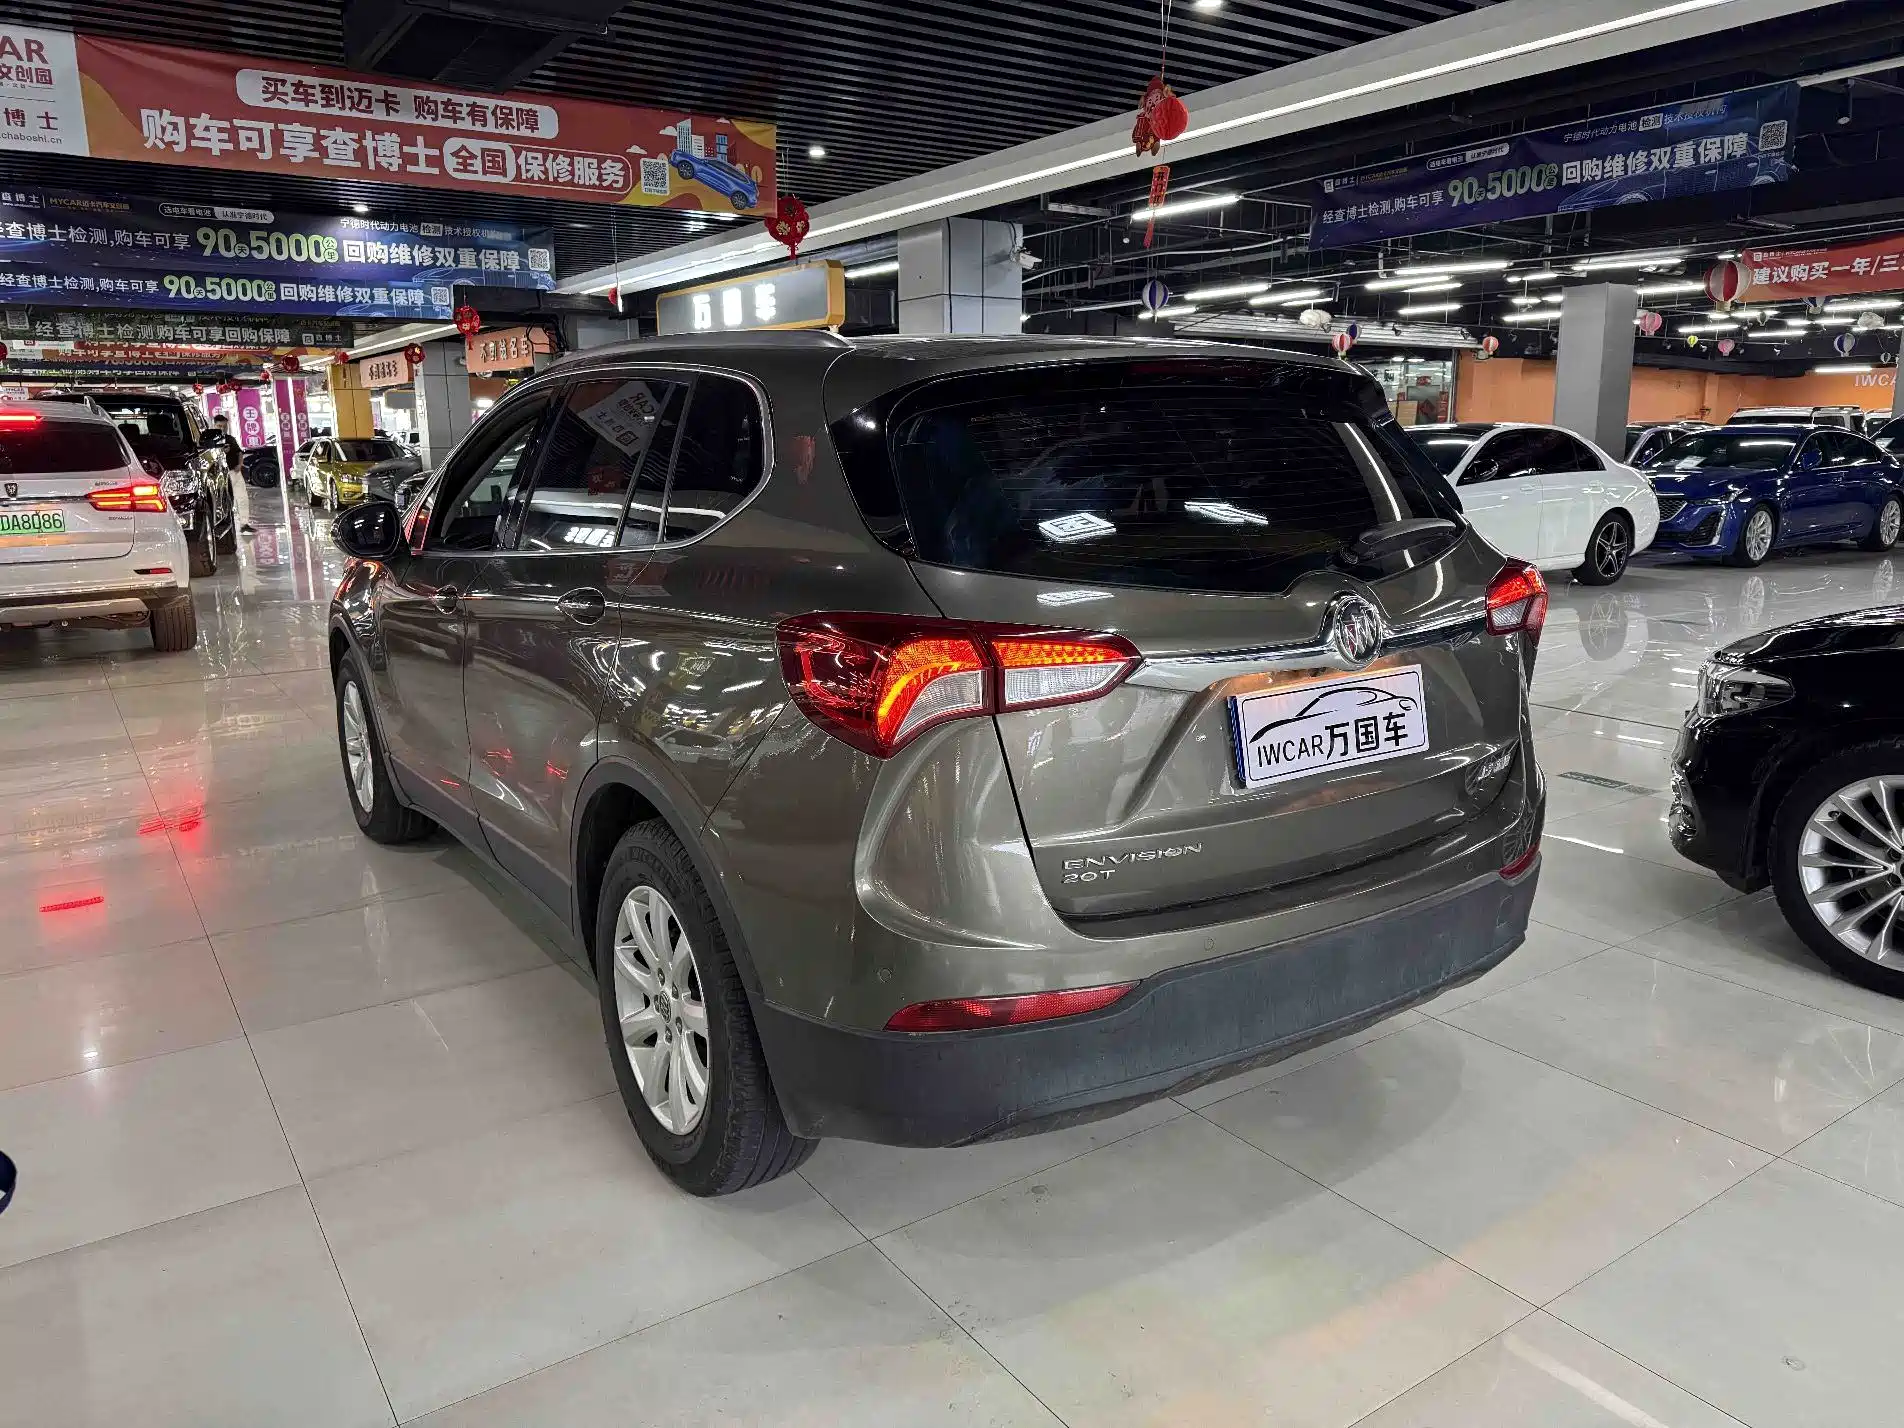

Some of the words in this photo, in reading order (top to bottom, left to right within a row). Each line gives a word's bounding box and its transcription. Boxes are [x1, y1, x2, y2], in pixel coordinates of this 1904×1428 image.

[261, 76, 401, 117] 买车到迈卡
[412, 94, 540, 134] 购车有保障
[343, 239, 521, 271] 回购维修双重保障
[1752, 253, 1904, 285] 建议购买一年/三
[280, 283, 425, 306] 回购维修双重保障
[1062, 842, 1202, 870] ENVISION
[1061, 869, 1116, 884] 20T
